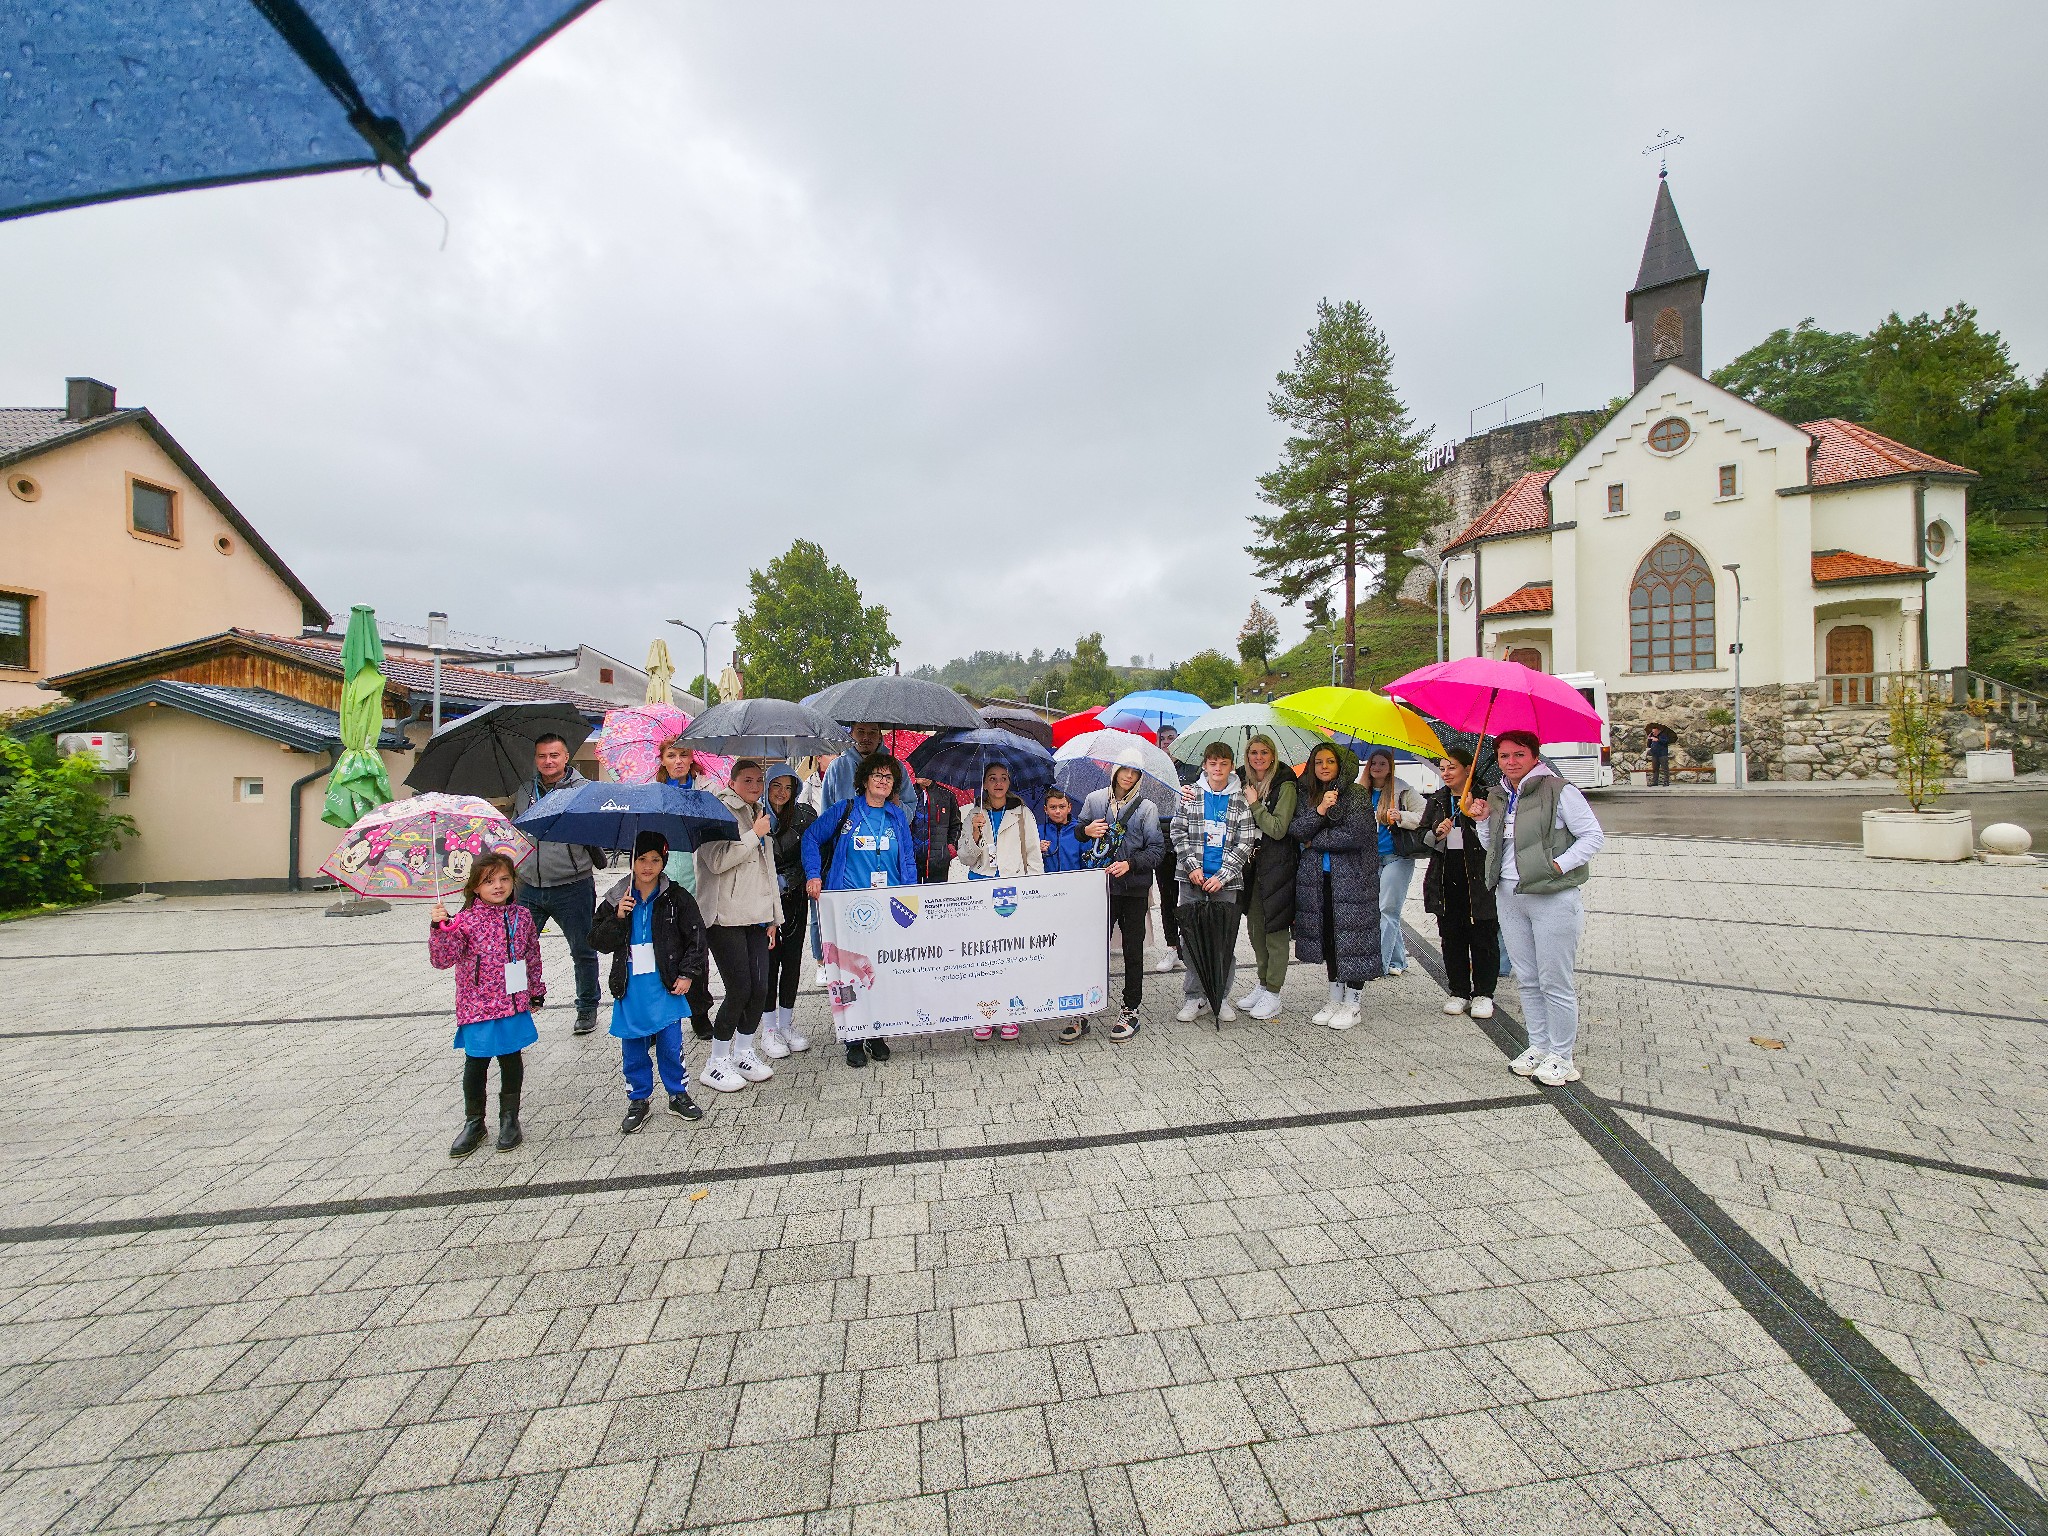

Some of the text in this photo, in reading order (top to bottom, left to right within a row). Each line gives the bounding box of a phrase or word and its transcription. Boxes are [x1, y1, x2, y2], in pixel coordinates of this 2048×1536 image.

[877, 945, 943, 964] EDUKATIVNO
[961, 936, 1025, 957] REKREATIVNI
[1029, 932, 1058, 950] KAMP
[1060, 998, 1081, 1007] USK
